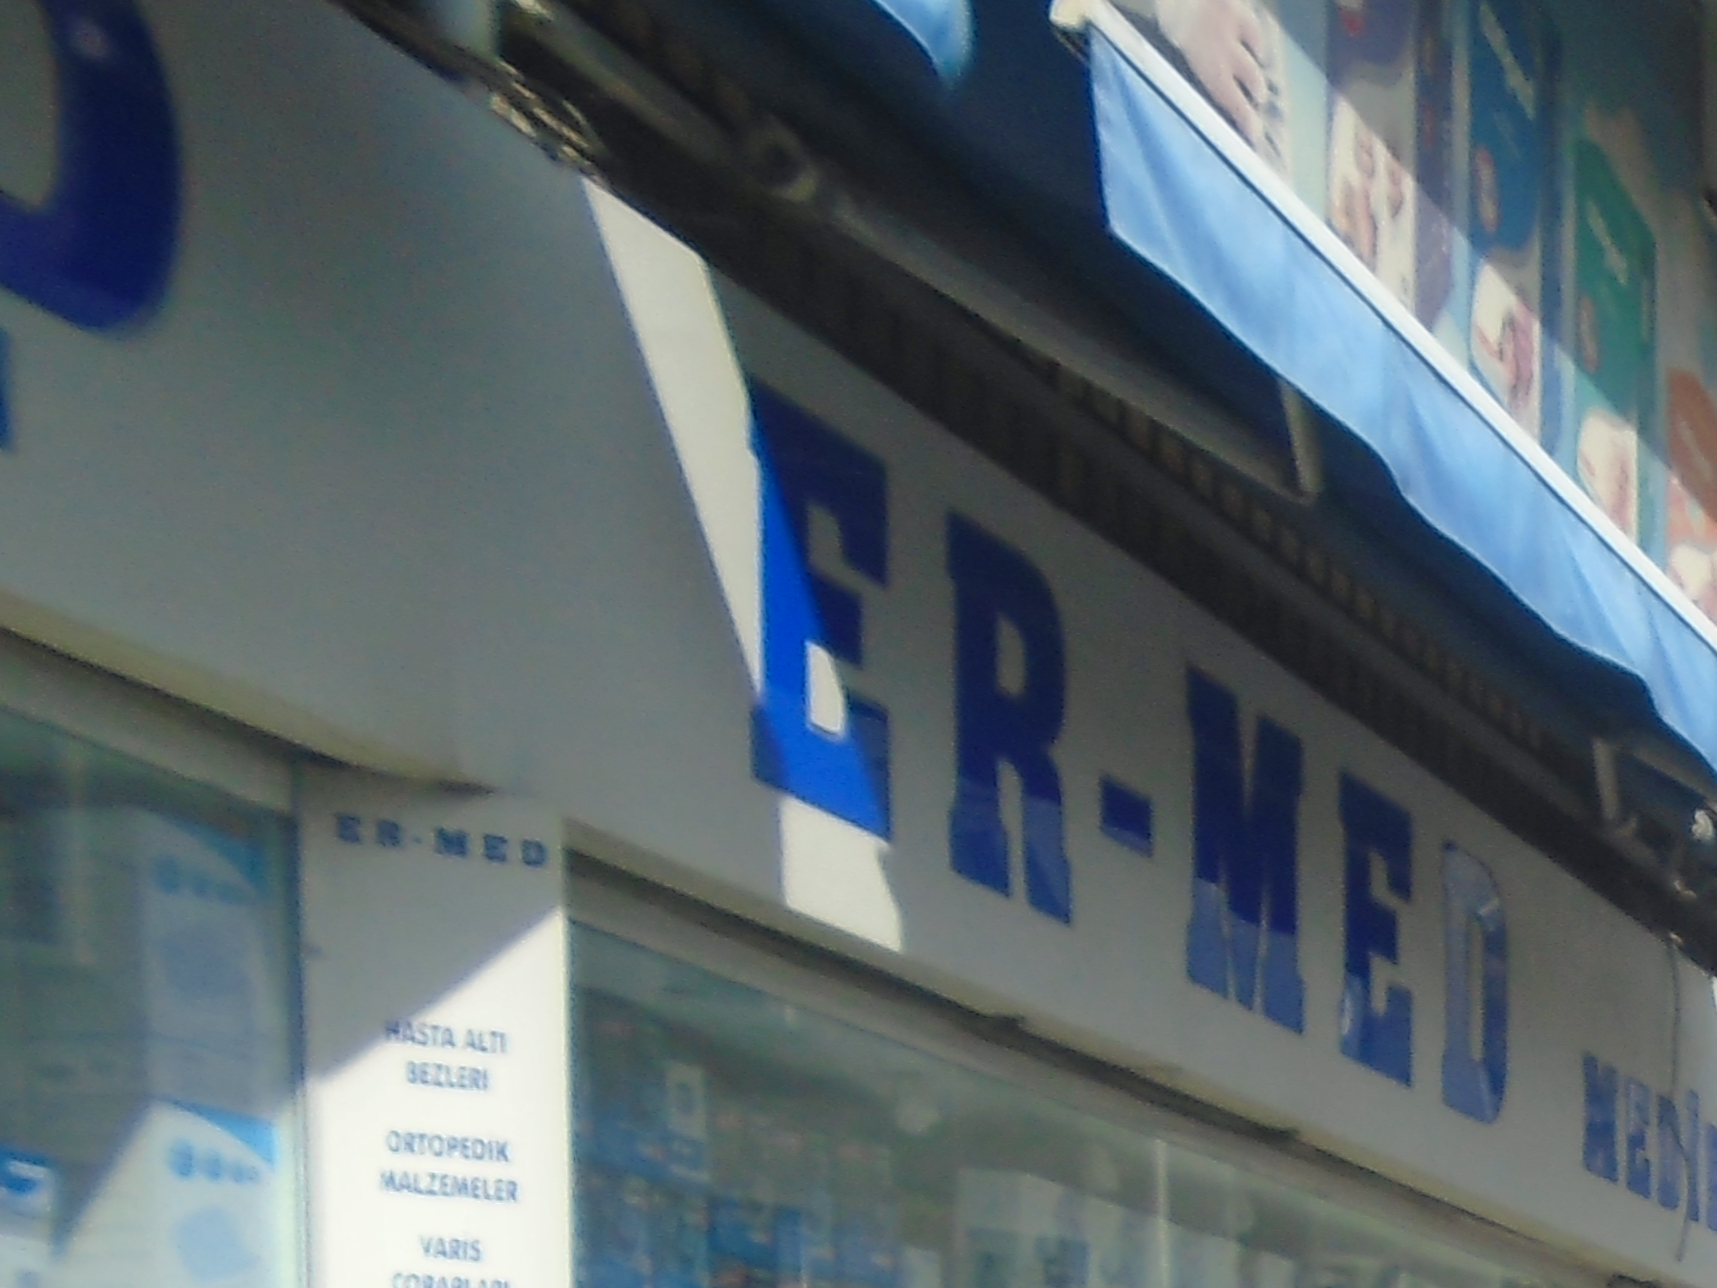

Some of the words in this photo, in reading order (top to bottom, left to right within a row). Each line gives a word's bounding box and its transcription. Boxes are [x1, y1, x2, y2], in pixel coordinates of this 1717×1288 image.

[748, 378, 1509, 1124] ER-MED
[336, 813, 549, 868] ER-MED
[385, 1019, 456, 1048] HASTA
[380, 1169, 520, 1202] MALZEMELER
